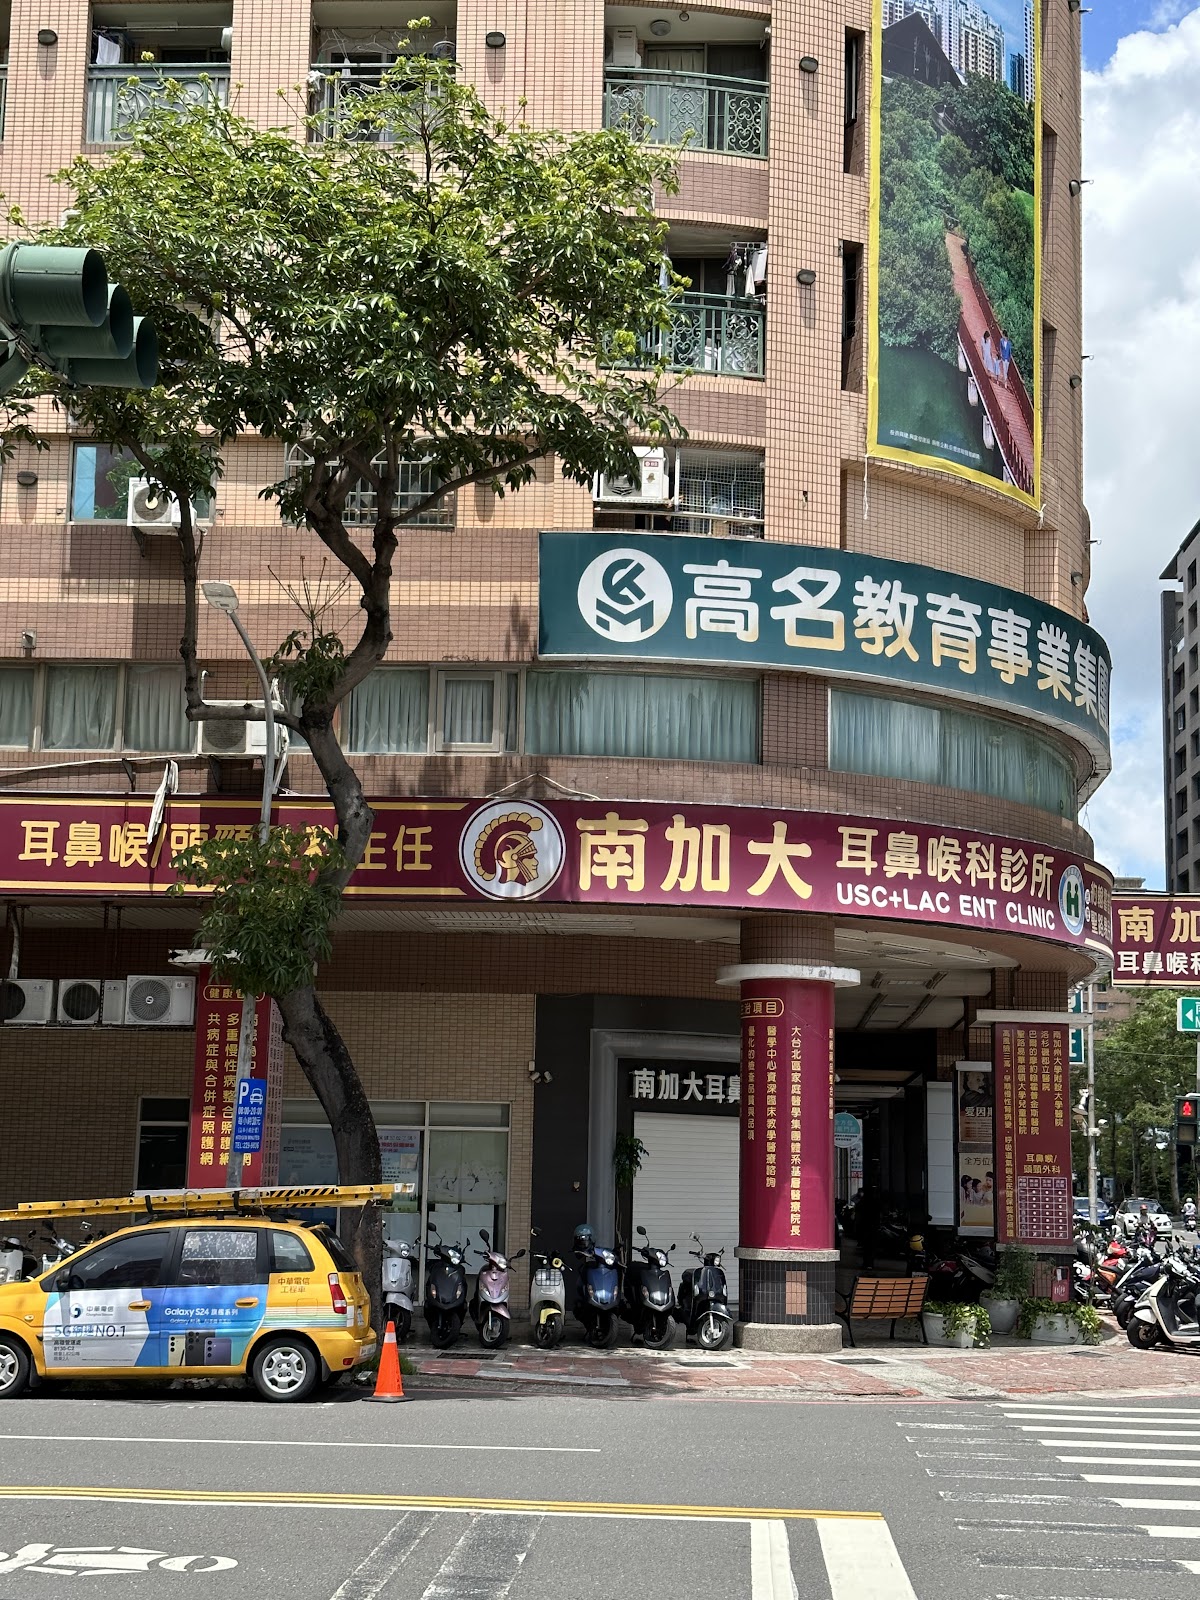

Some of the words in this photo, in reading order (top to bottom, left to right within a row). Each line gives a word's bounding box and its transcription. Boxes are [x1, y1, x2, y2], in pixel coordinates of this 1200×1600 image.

[682, 559, 1109, 736] 高名教育事業集團
[576, 811, 813, 899] 南加大
[836, 826, 1055, 902] 耳鼻喉科診所
[836, 883, 950, 915] USC+LAC
[959, 897, 999, 921] ENT
[1005, 901, 1056, 932] CLINIC
[1117, 905, 1200, 943] 南加
[199, 1012, 221, 1166] 共病症與合併症照護網
[239, 1082, 249, 1105] P
[964, 1156, 993, 1166] 全方位
[1023, 1164, 1061, 1174] 頭頸外科
[277, 1277, 310, 1286] 中華電信
[280, 1286, 306, 1294] 工程車
[86, 1305, 114, 1313] 中華電信
[164, 1307, 194, 1317] Galaxy
[195, 1307, 210, 1316] S24
